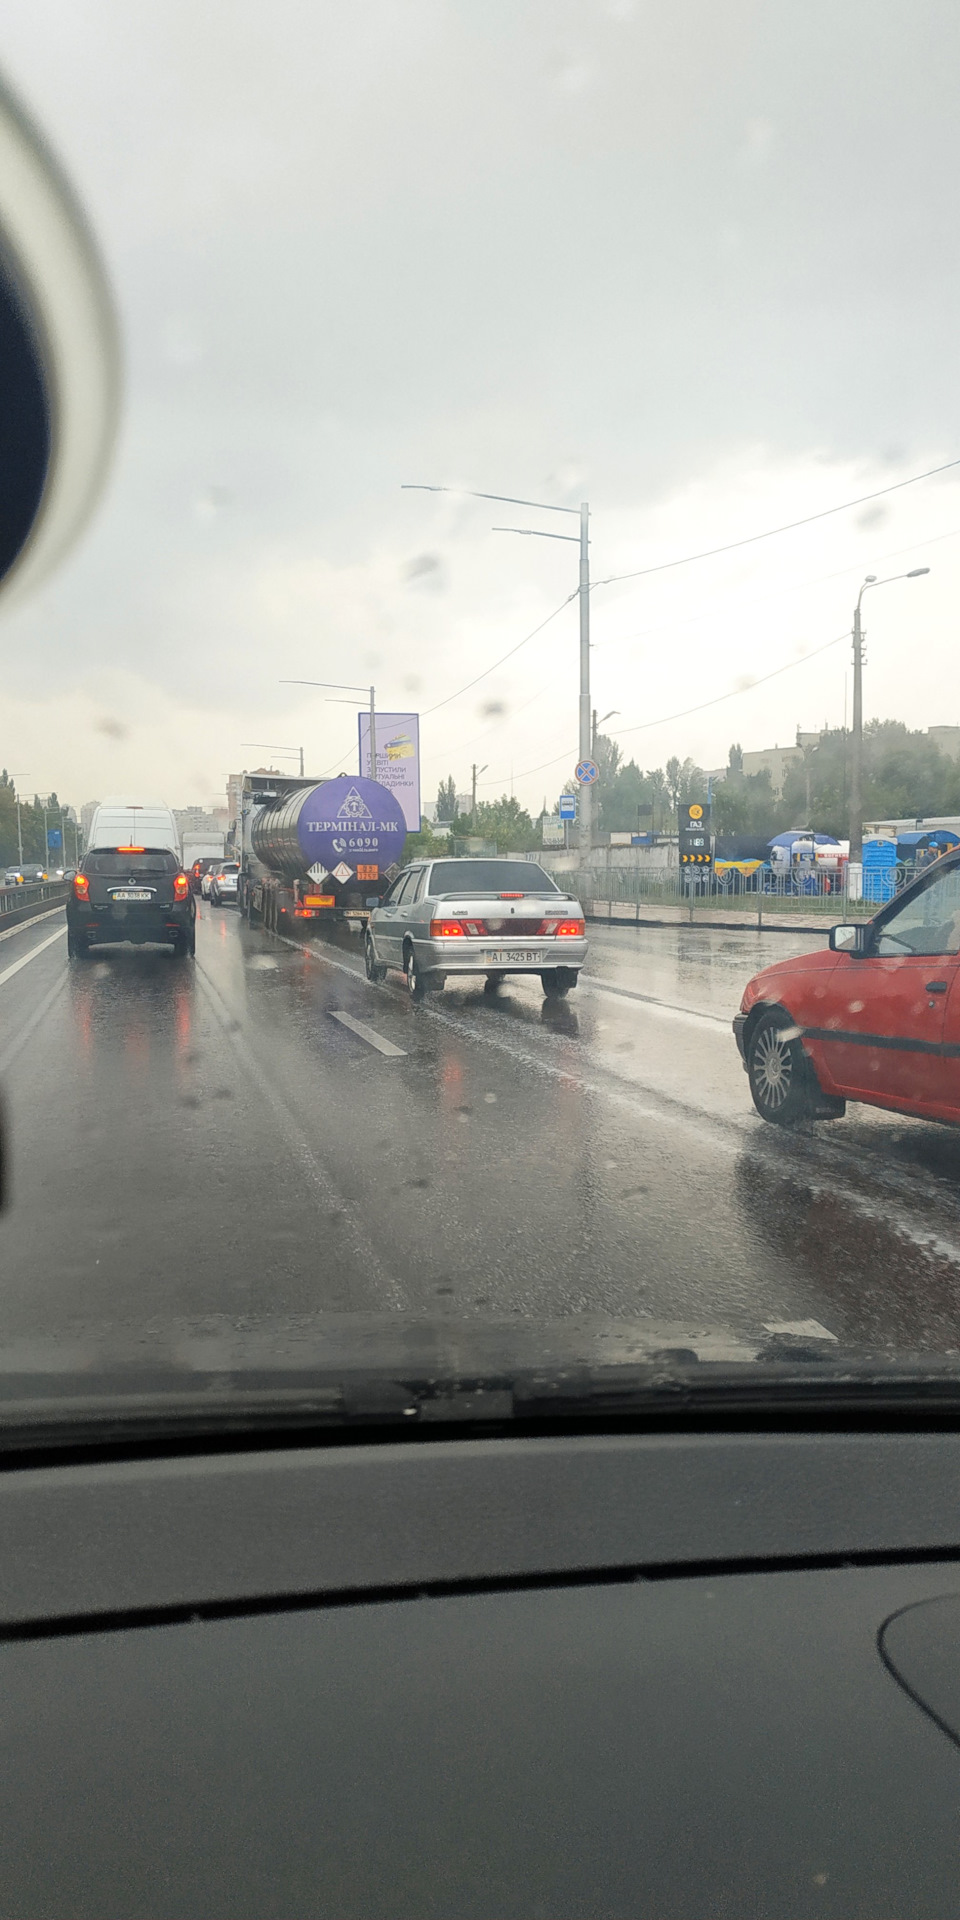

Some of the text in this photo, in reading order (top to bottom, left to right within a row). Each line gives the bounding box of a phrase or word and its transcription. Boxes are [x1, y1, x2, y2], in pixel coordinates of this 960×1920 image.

[306, 821, 399, 832] ТЕРМІНАЛ-МК
[348, 837, 379, 847] 6090
[506, 952, 525, 961] 3425
